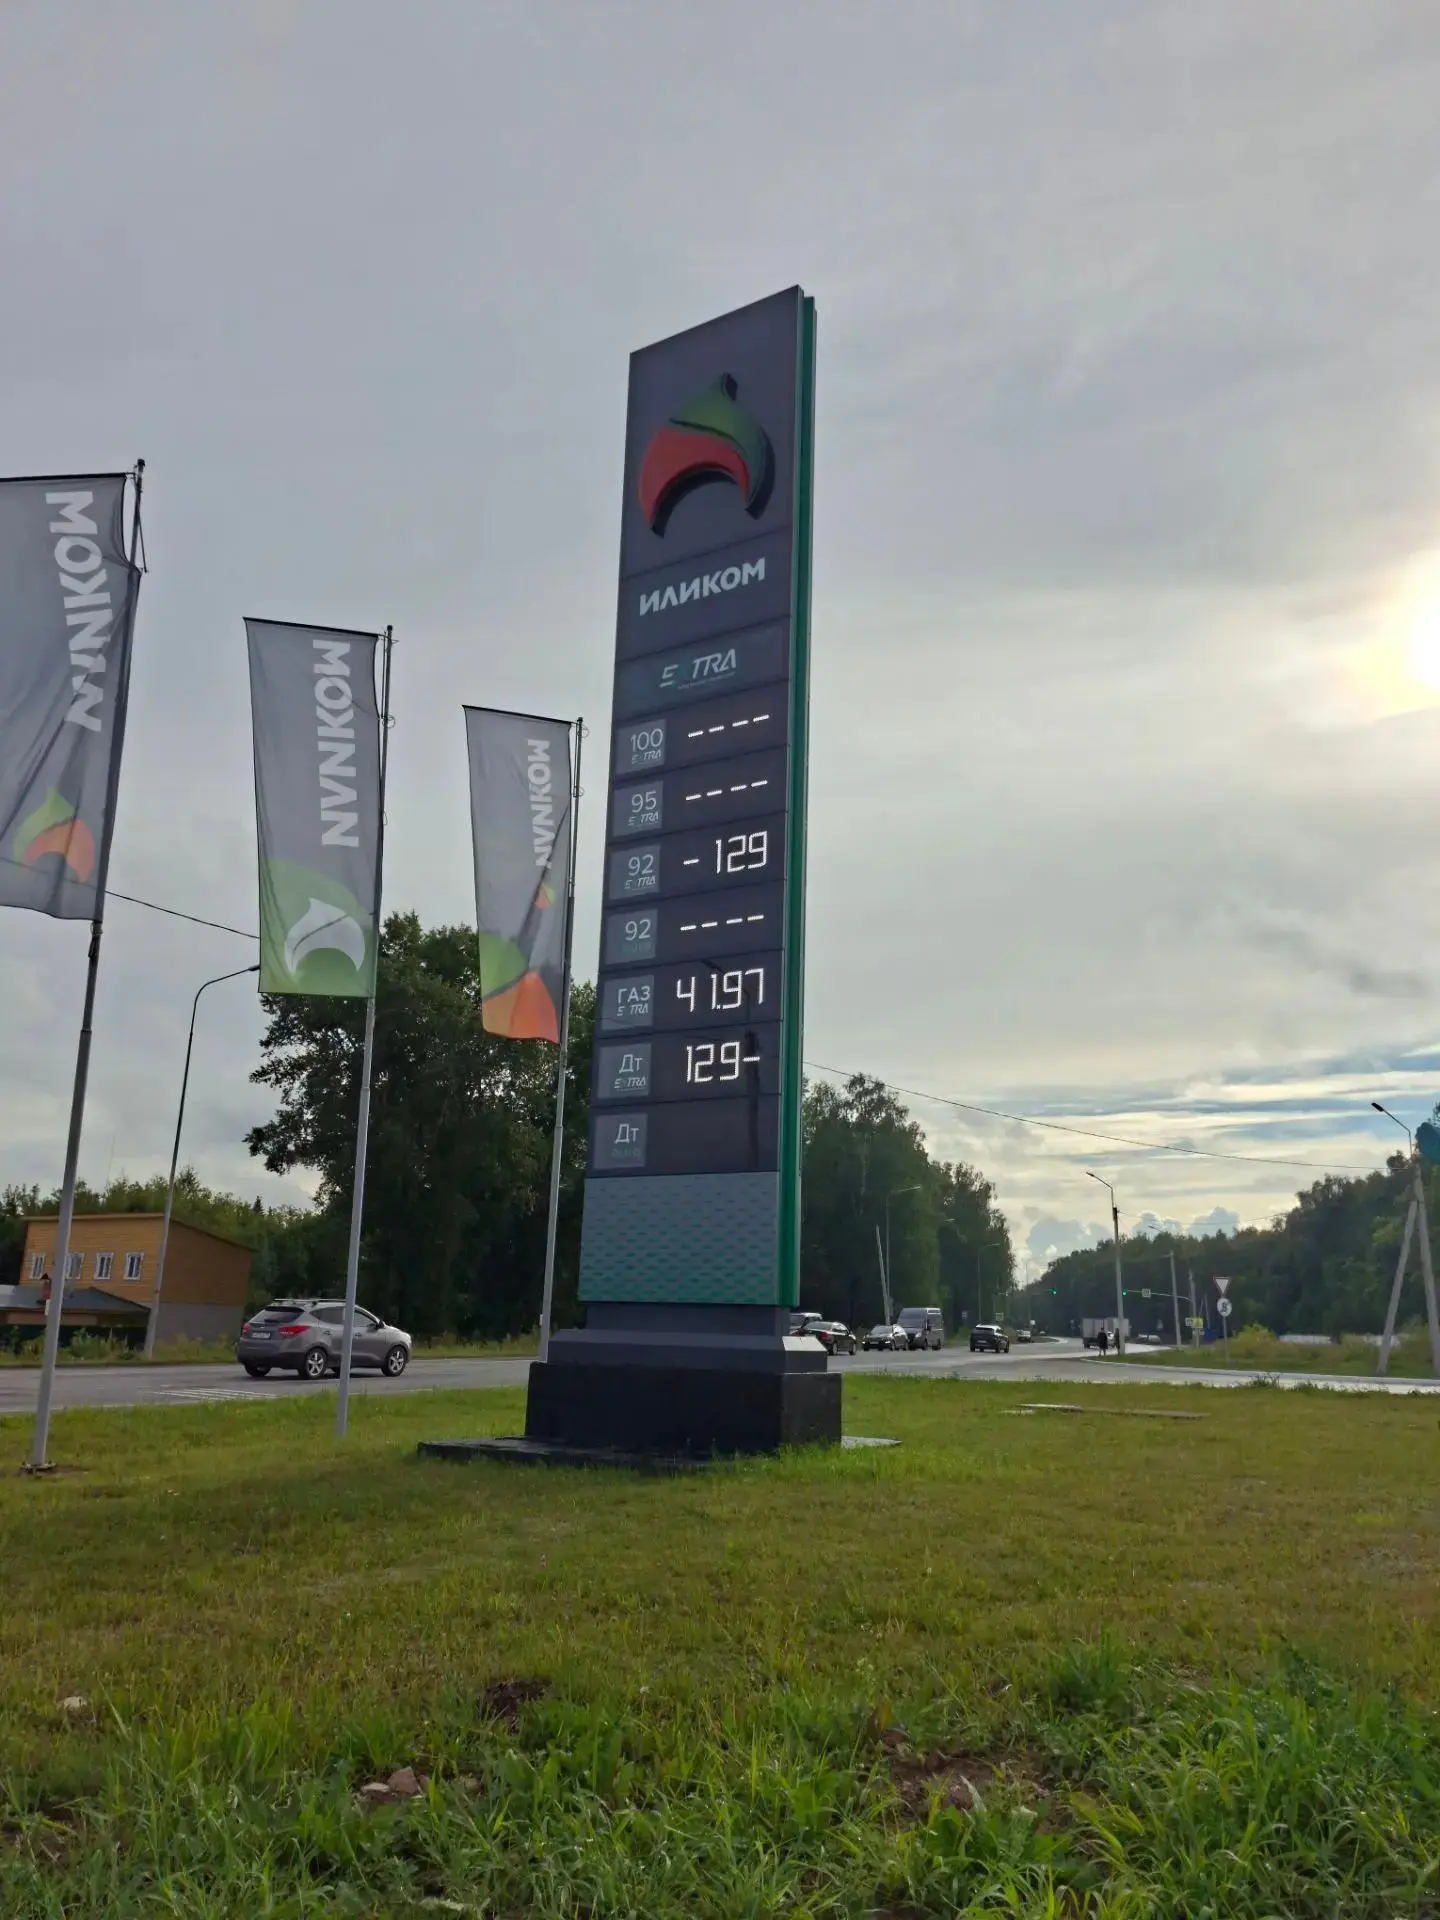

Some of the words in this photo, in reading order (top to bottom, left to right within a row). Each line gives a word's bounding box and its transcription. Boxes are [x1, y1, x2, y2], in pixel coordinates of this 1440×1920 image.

[639, 556, 766, 616] ИЛИКОМ
[659, 648, 737, 688] ETRA
[630, 728, 664, 752] 100
[631, 749, 662, 765] ETRA
[631, 790, 657, 813] 95
[627, 811, 660, 827] ETRA
[628, 854, 654, 877] 92
[624, 875, 656, 890] ETRA
[625, 918, 651, 941] 92
[618, 985, 651, 1003] ГАЗ
[617, 1003, 649, 1017] ETRA
